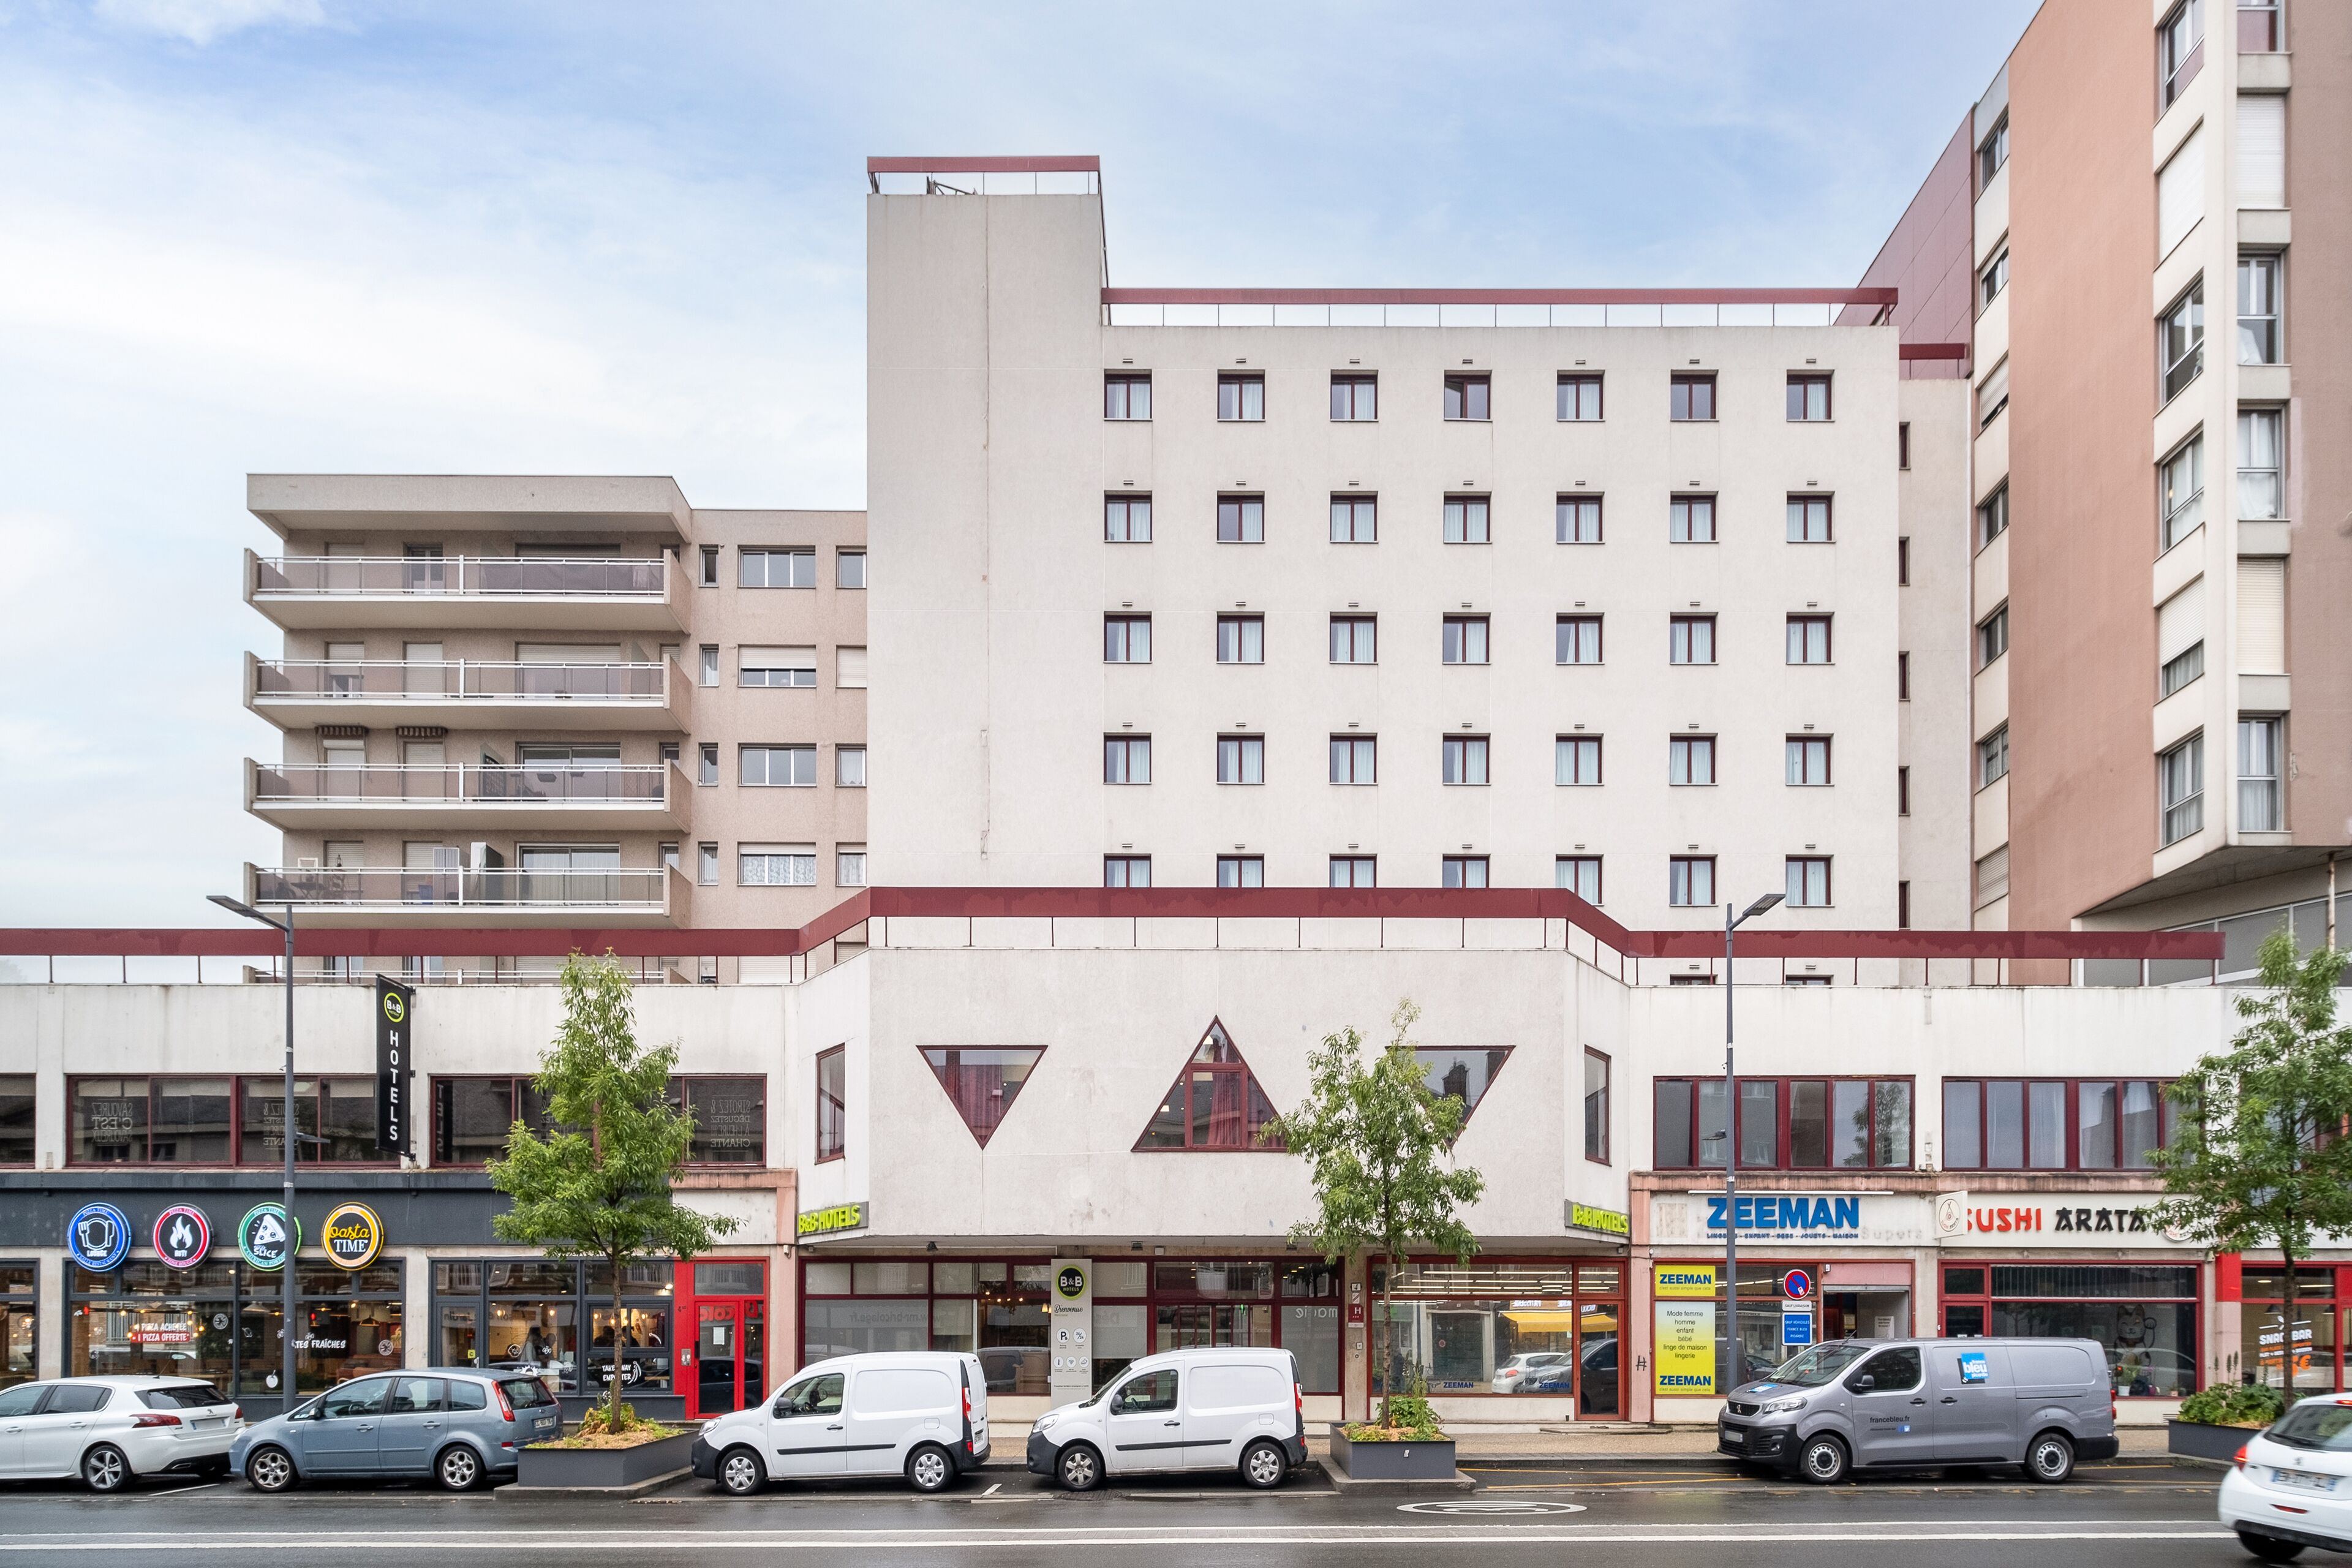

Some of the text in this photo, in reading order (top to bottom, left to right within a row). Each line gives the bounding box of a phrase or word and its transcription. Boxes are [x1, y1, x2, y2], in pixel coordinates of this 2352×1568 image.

[386, 999, 401, 1014] B&B
[389, 1030, 399, 1140] HOTELS
[799, 1205, 861, 1233] B&B HOTELS
[1572, 1204, 1629, 1233] B&B HOTELS
[1707, 1197, 1860, 1228] ZEEMAN
[2055, 1207, 2147, 1232] ARATA
[330, 1223, 370, 1240] pasta
[254, 1248, 278, 1258] SLICE
[334, 1240, 368, 1253] TIME
[1060, 1276, 1083, 1287] B&B
[1659, 1274, 1711, 1284] ZEEMAN
[2259, 1329, 2312, 1345] SNAC BAR
[1962, 1362, 1988, 1373] bleu
[1659, 1375, 1711, 1385] ZEEMAN
